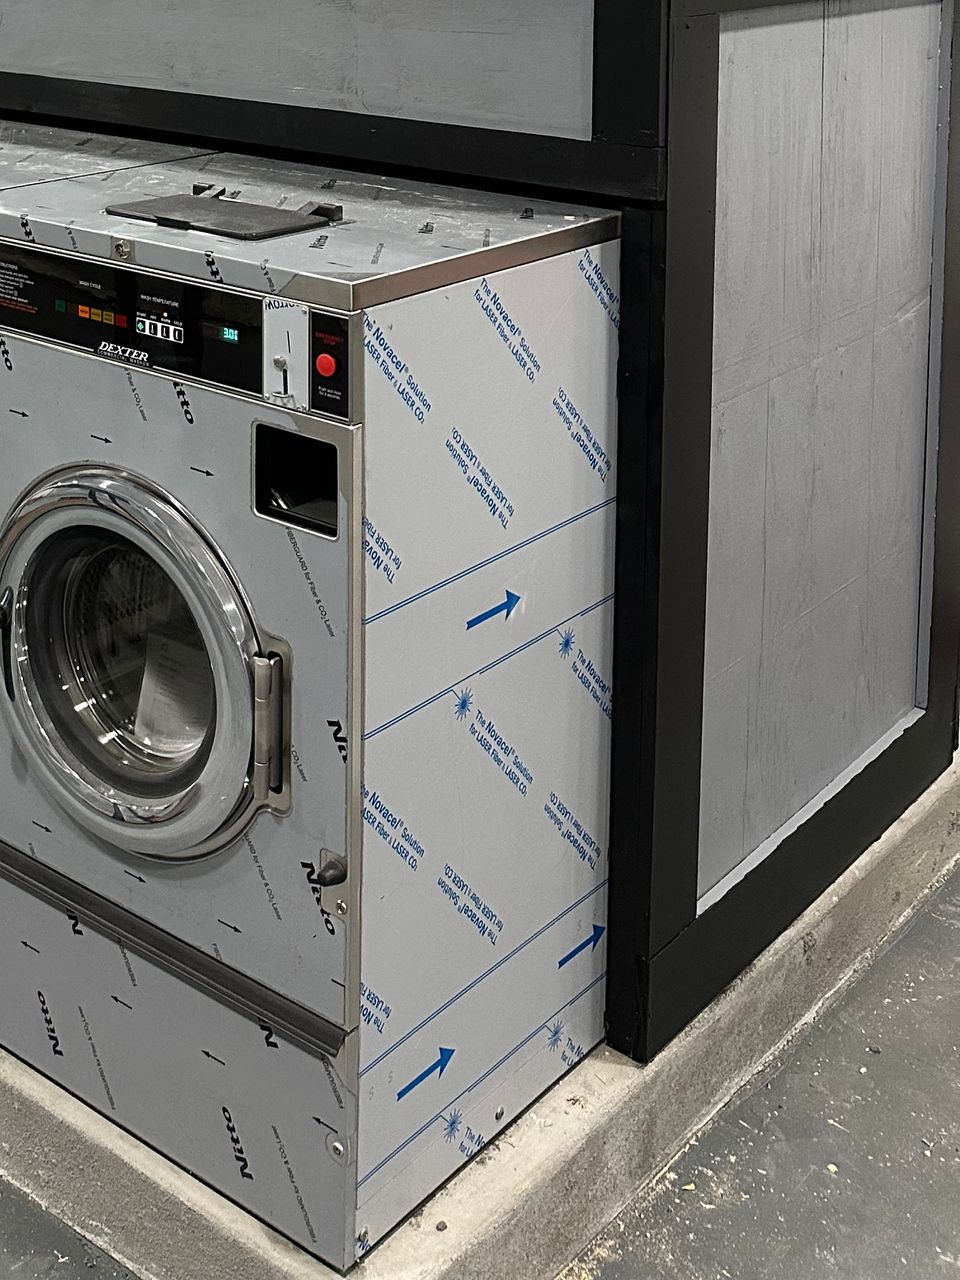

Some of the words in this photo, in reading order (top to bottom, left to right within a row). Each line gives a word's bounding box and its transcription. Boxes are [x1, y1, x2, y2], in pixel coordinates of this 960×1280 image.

[583, 248, 594, 267] The
[578, 259, 586, 273] for
[584, 270, 599, 295] LASER
[473, 289, 483, 303] for
[481, 300, 498, 327] LASER
[496, 322, 510, 344] Fiber
[511, 345, 527, 371] LASER
[480, 277, 492, 296] The
[520, 337, 541, 373] Solution
[98, 341, 149, 362] DEXTER
[363, 335, 380, 363] LASER
[380, 359, 395, 382] Fiber
[396, 383, 416, 411] LASER
[172, 381, 194, 425] itto
[406, 374, 431, 413] Solution
[552, 397, 573, 431] Solution
[565, 398, 581, 423] LASER
[445, 439, 469, 475] Solution
[460, 439, 478, 466] LASER
[592, 438, 606, 462] LASER
[479, 466, 493, 487] Fiber
[597, 465, 607, 483] The
[604, 458, 612, 471] for
[491, 482, 508, 508] LASER
[498, 510, 509, 530] The
[506, 503, 515, 517] for
[362, 539, 384, 570] Nova
[375, 532, 394, 560] LASER
[383, 563, 395, 584] The
[392, 555, 402, 570] for
[308, 581, 319, 598] Fiber
[324, 618, 336, 638] Laser
[576, 648, 587, 666] The
[469, 722, 478, 737] for
[476, 731, 492, 755] LASER
[490, 748, 504, 767] Fiber
[504, 765, 520, 788] LASER
[475, 709, 487, 728] The
[512, 755, 534, 785] Solution
[296, 763, 308, 783] Laser
[360, 807, 377, 828] ASER
[375, 821, 390, 841] Fiber
[391, 838, 410, 862] LASER
[401, 827, 425, 858] Solution
[437, 876, 460, 906] Solution
[452, 873, 469, 895] LASER
[481, 903, 497, 925] LASER
[487, 929, 498, 946] The
[366, 989, 384, 1012] LASER
[382, 1004, 392, 1019] for
[37, 990, 64, 1057] Nitto
[373, 1016, 385, 1035] The
[221, 1105, 254, 1180] Nitto
[465, 1126, 476, 1143] The
